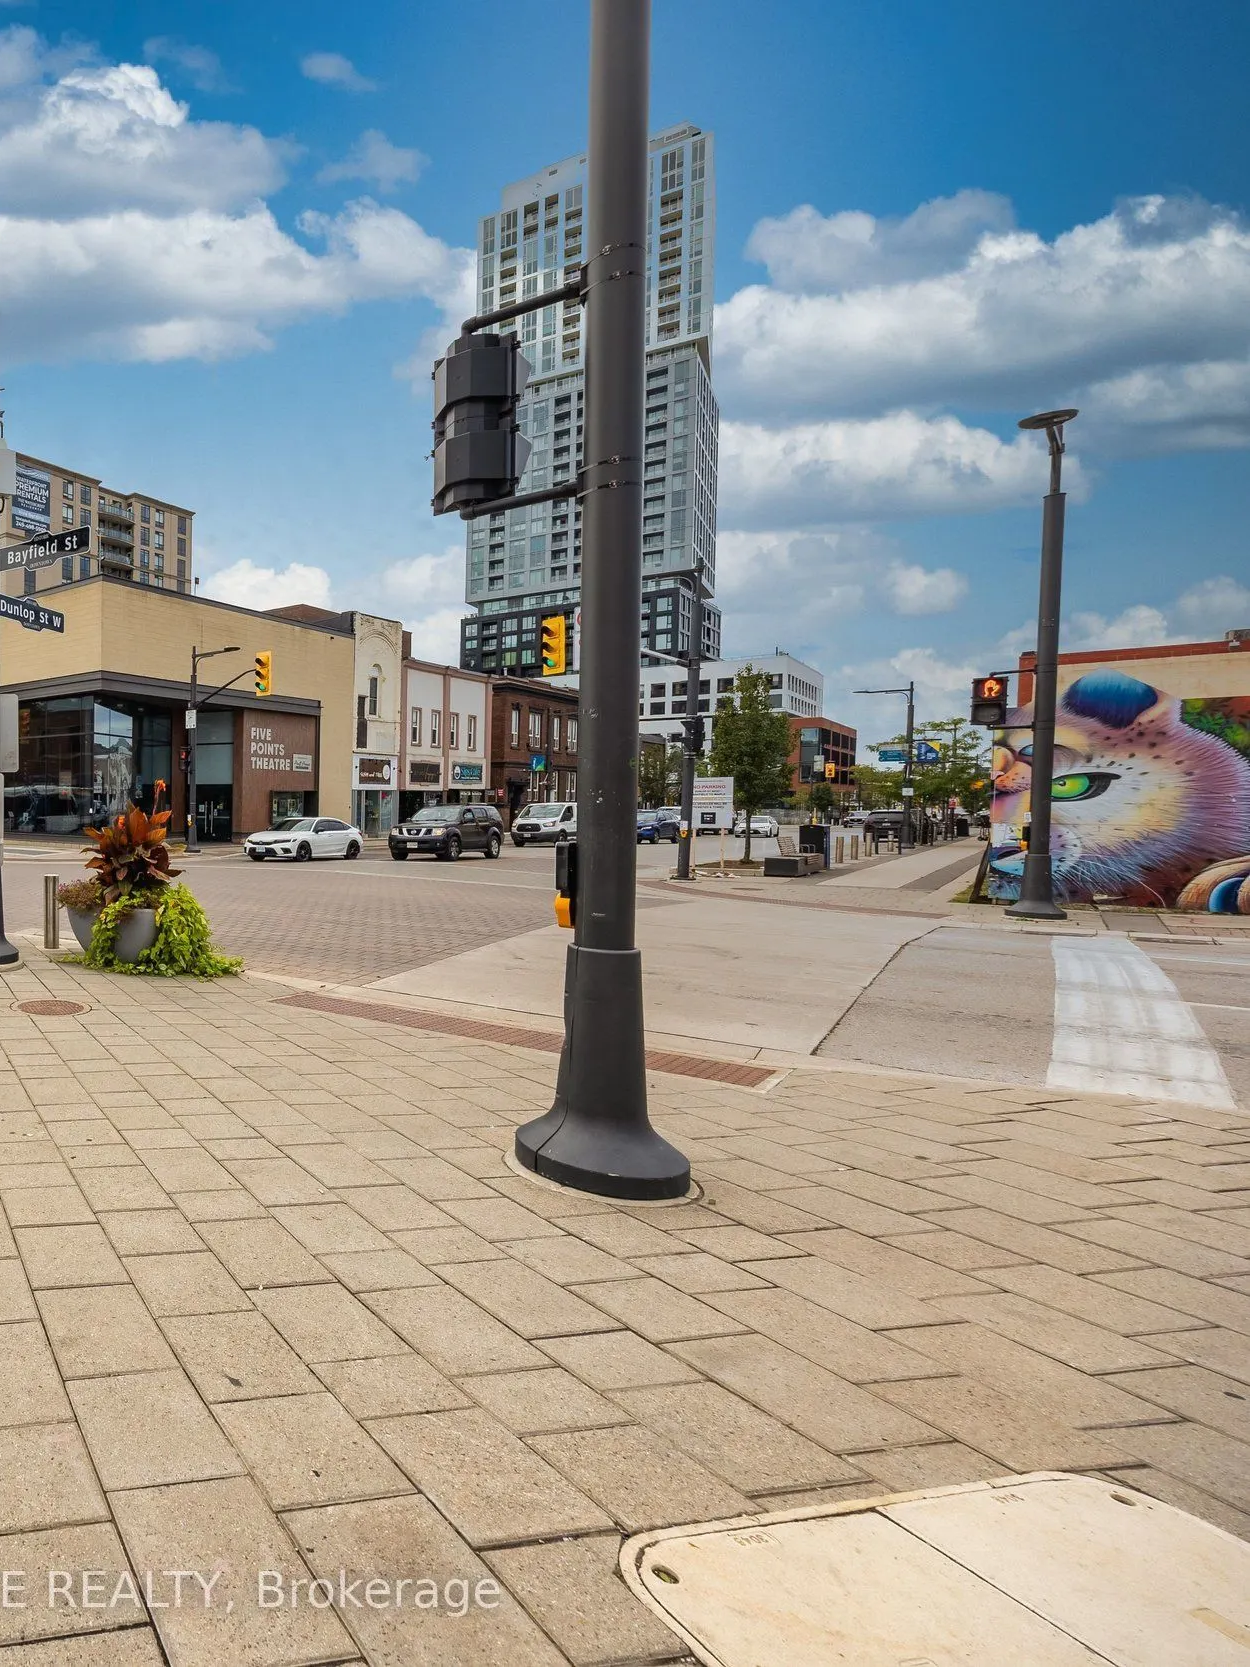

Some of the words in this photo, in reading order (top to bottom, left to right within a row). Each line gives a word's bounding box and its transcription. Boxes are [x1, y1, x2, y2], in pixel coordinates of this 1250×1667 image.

[15, 481, 49, 497] PREMIUM
[16, 489, 46, 503] RENTALS
[7, 540, 57, 564] Bayfield
[64, 535, 78, 550] St
[0, 599, 35, 622] Dunlop
[39, 611, 49, 624] St
[52, 615, 62, 628] W
[250, 727, 272, 741] FIVE
[250, 742, 285, 756] POINTS
[250, 757, 291, 771] THEATRE
